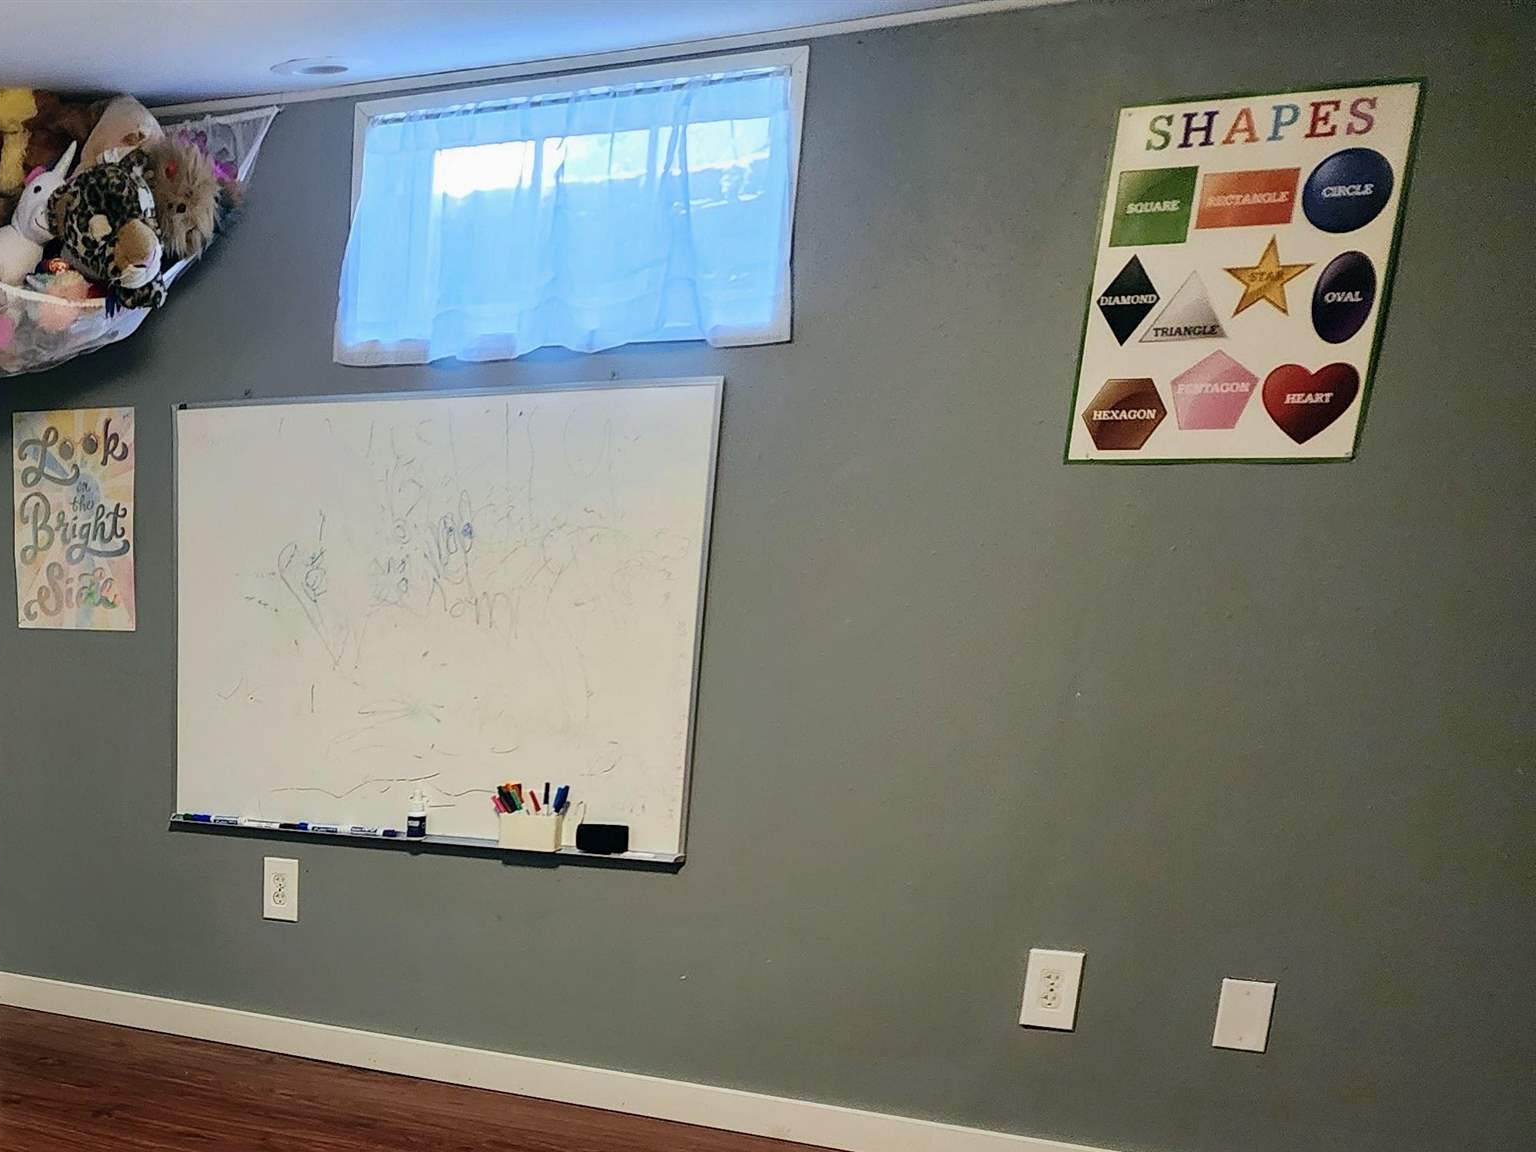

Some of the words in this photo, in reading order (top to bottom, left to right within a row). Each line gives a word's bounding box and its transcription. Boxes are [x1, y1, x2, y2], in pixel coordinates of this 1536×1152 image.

[1145, 96, 1378, 151] SHAPES
[1125, 199, 1180, 214] SQUARE
[1207, 191, 1290, 208] RECTANGLE
[1321, 183, 1375, 198] CIRCLE
[1248, 269, 1284, 282] STAR
[1099, 293, 1158, 307] DIAMOND
[1324, 291, 1363, 303] OVAL
[1152, 324, 1219, 337] TRIANGLE
[1177, 381, 1250, 394] PENTAGON
[1284, 391, 1333, 404] HEART
[1092, 408, 1156, 421] HEXAGON
[71, 498, 95, 513] the
[20, 491, 130, 565] Bright
